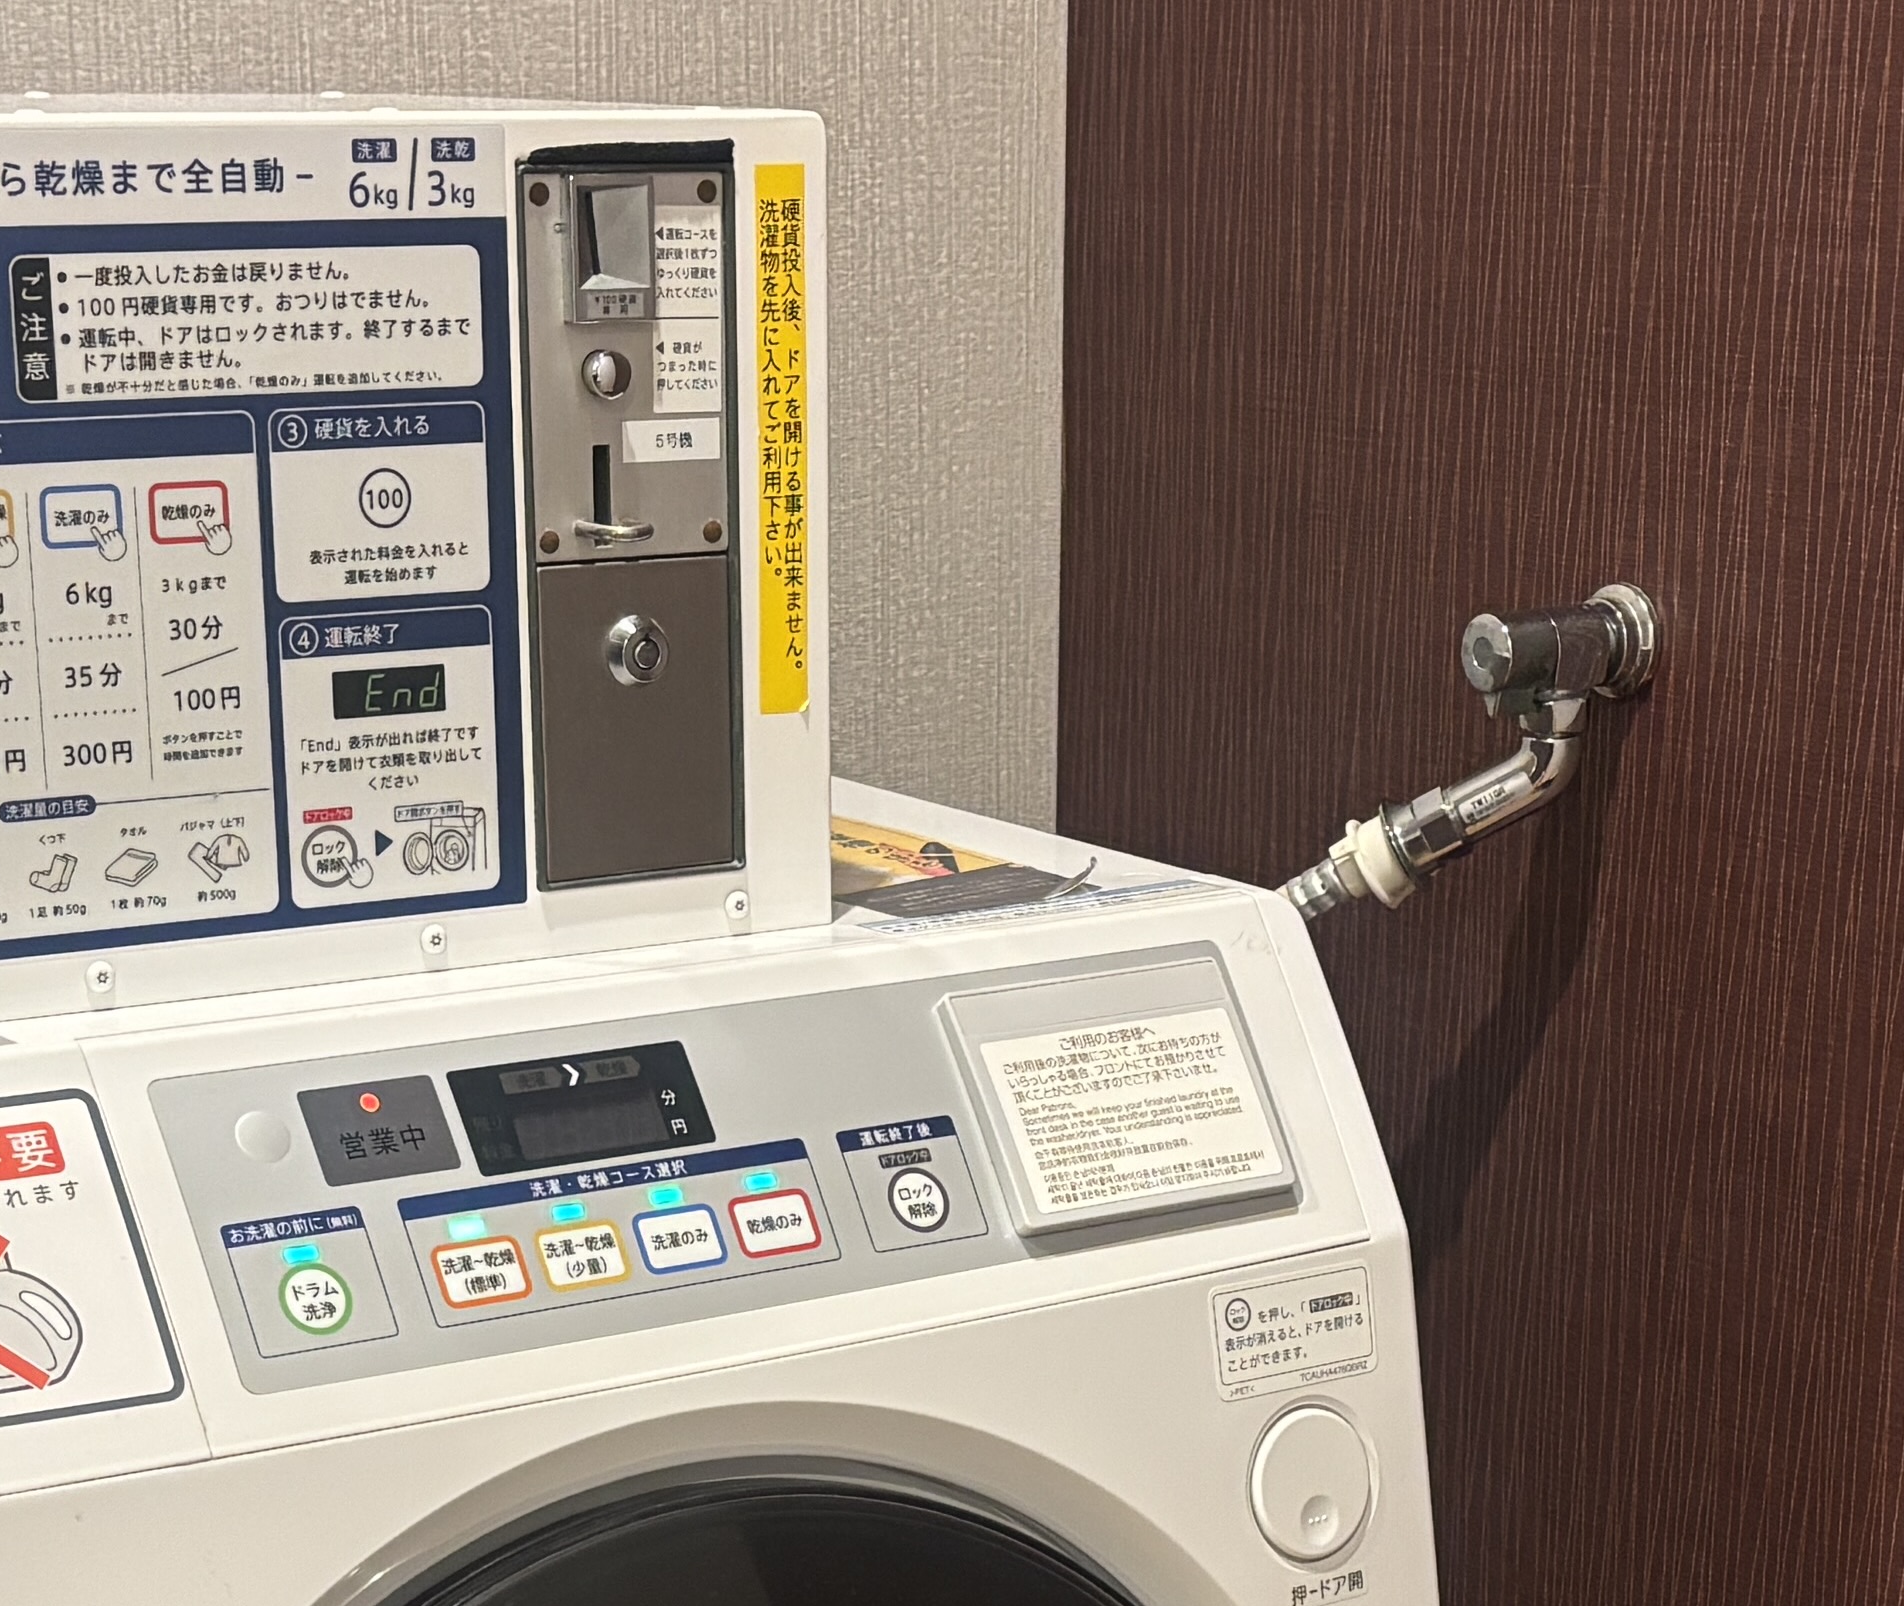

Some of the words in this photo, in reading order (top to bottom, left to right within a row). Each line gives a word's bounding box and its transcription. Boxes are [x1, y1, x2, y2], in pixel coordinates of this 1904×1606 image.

[357, 141, 392, 160] 洗濯
[435, 141, 471, 160] 洗乾
[349, 171, 398, 209] 6kg
[428, 170, 475, 208] 3kg
[73, 261, 352, 287] 一度投入したお金は戻りません。
[656, 286, 718, 299] 入れてください
[20, 270, 51, 382] ご注意
[77, 317, 472, 349] 運転中、ドアはロックされます。終了するまで
[82, 350, 244, 374] ドアは開きません。
[657, 360, 718, 373] つまった時に
[759, 199, 783, 578] 洗濯物を先に入れてご利用下さい。
[313, 415, 431, 440] 硬貨を入れる
[780, 199, 804, 670] 硬貨投入後、ドアを開ける事が出来ません。
[655, 432, 693, 450] 5号機
[366, 487, 403, 510] 100
[53, 509, 110, 528] 洗濯のみ
[162, 503, 216, 521] 乾燥のみ
[309, 541, 470, 565] 表示された料金を入れると
[344, 565, 438, 586] 運転を始めます
[0, 621, 22, 633] まで
[106, 613, 129, 626] まで
[324, 623, 400, 649] 運転終了
[64, 661, 123, 689] 35分
[169, 615, 223, 640] 30分
[173, 686, 241, 711] 100円
[365, 671, 440, 713] End
[62, 739, 133, 767] 300円
[300, 746, 483, 775] ドアを開けて衣類を取り出して
[367, 774, 420, 790] ください
[5, 799, 90, 820] 洗濯量の目安
[311, 840, 346, 856] ロック
[660, 1089, 677, 1106] 分
[670, 1118, 688, 1135] 円
[858, 1122, 933, 1147] 運転終了後
[339, 1123, 427, 1161] 営業中
[529, 1159, 688, 1198] 洗濯・乾燥コース選択
[898, 1183, 933, 1201] ロック
[907, 1201, 938, 1220] 解除
[228, 1216, 324, 1244] お洗濯の前に
[746, 1213, 802, 1235] 乾燥のみ
[650, 1228, 708, 1251] 洗濯のみ
[566, 1256, 608, 1279] (少量)
[291, 1281, 340, 1302] ドラム
[464, 1272, 507, 1296] (標準)
[302, 1301, 337, 1321] 洗浄
[1257, 1306, 1295, 1324] を押し、
[1225, 1313, 1364, 1352] 表示が消えると、ドアを開ける
[1228, 1347, 1308, 1373] ことができます。
